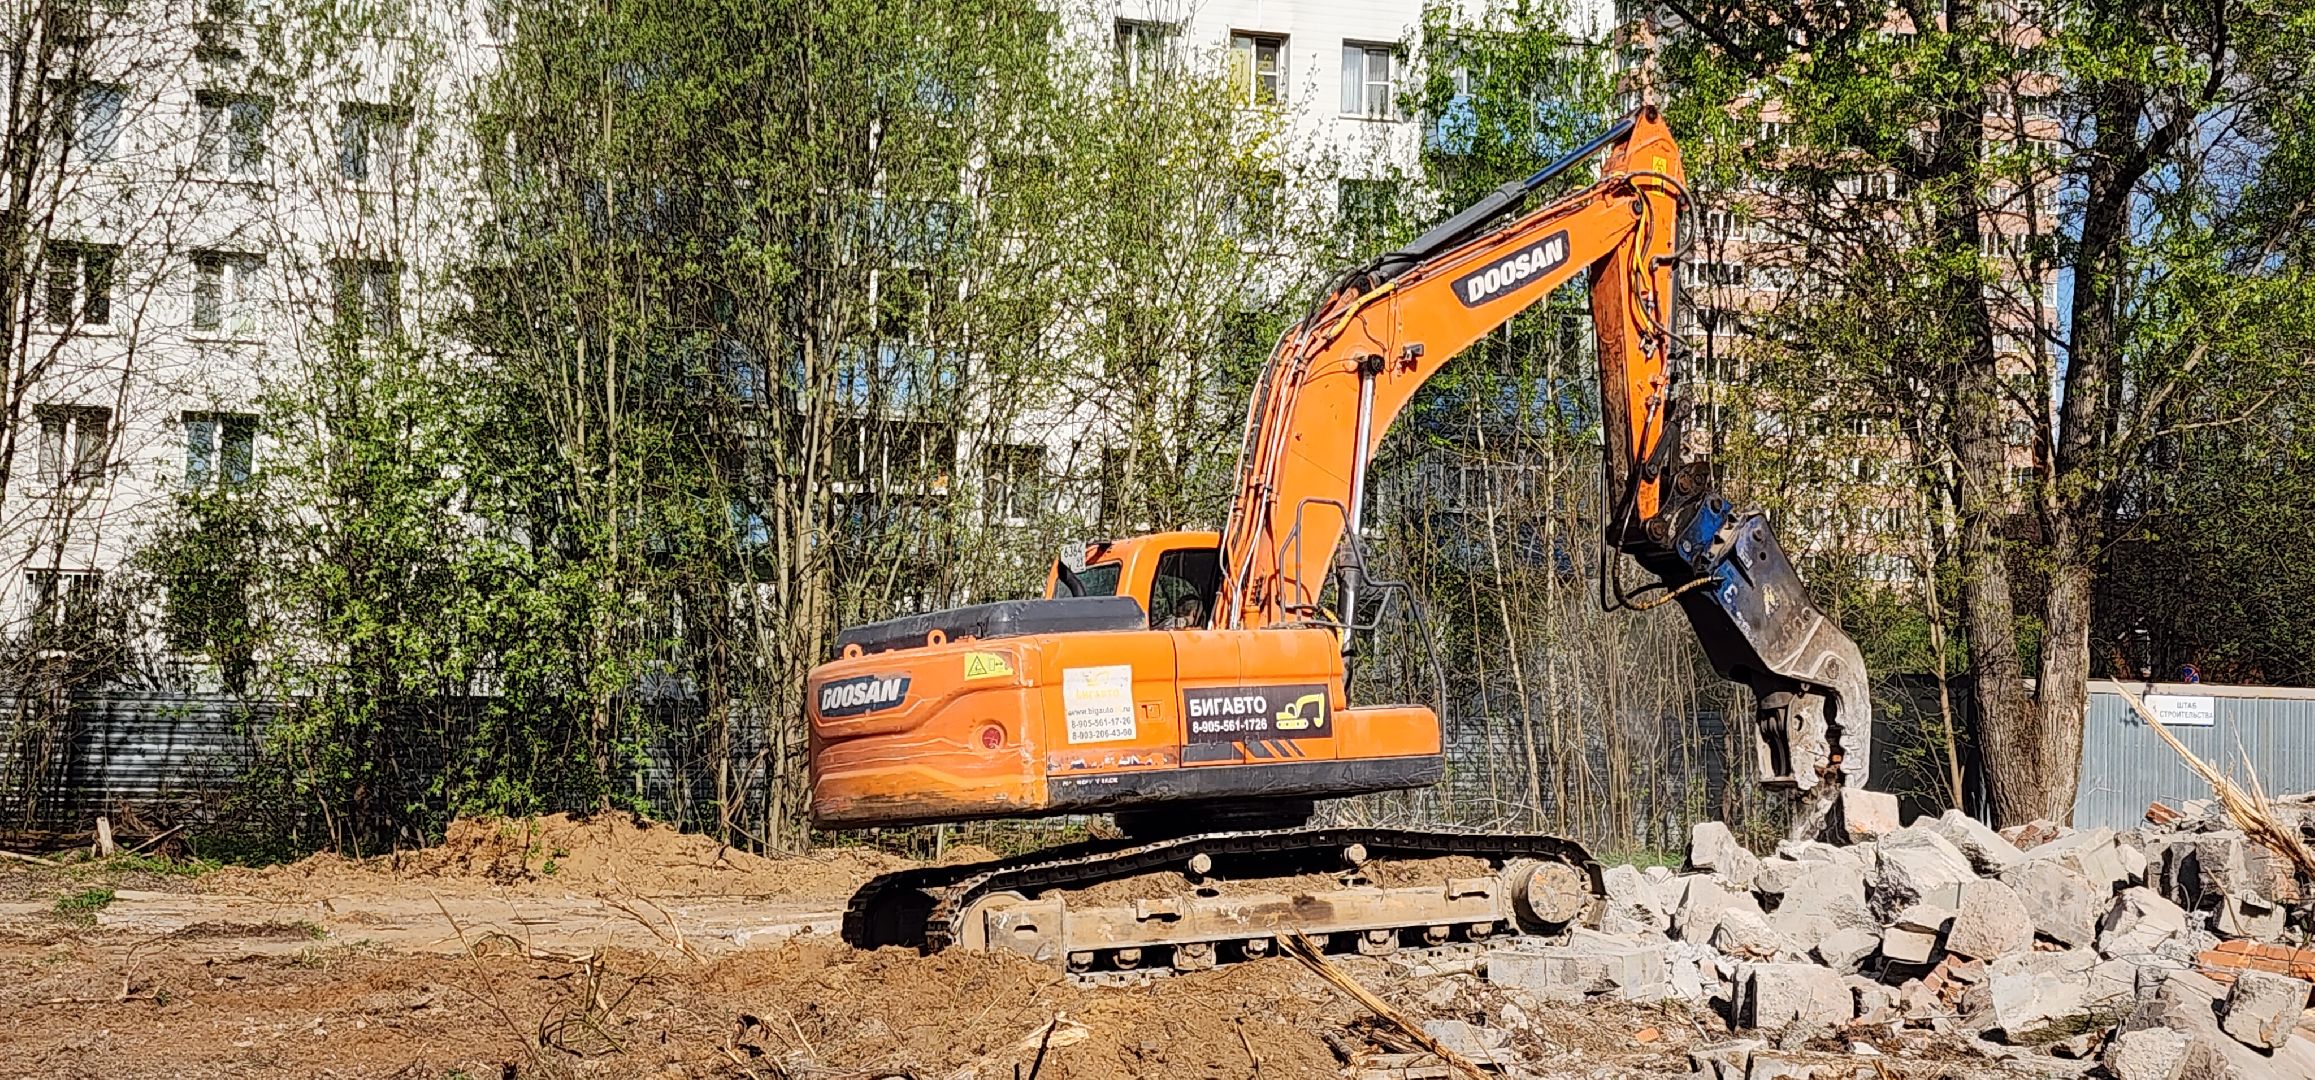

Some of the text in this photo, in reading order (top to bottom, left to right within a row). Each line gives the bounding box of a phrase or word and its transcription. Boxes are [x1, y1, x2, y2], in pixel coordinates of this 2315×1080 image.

[1467, 237, 1563, 303] DOOSAN
[821, 678, 901, 711] DOOSAN
[1189, 695, 1267, 717] БИГАВТО
[2160, 710, 2213, 719] СТРОИТЕЛЬСТВА
[1192, 718, 1267, 733] 8-905-561-1726
